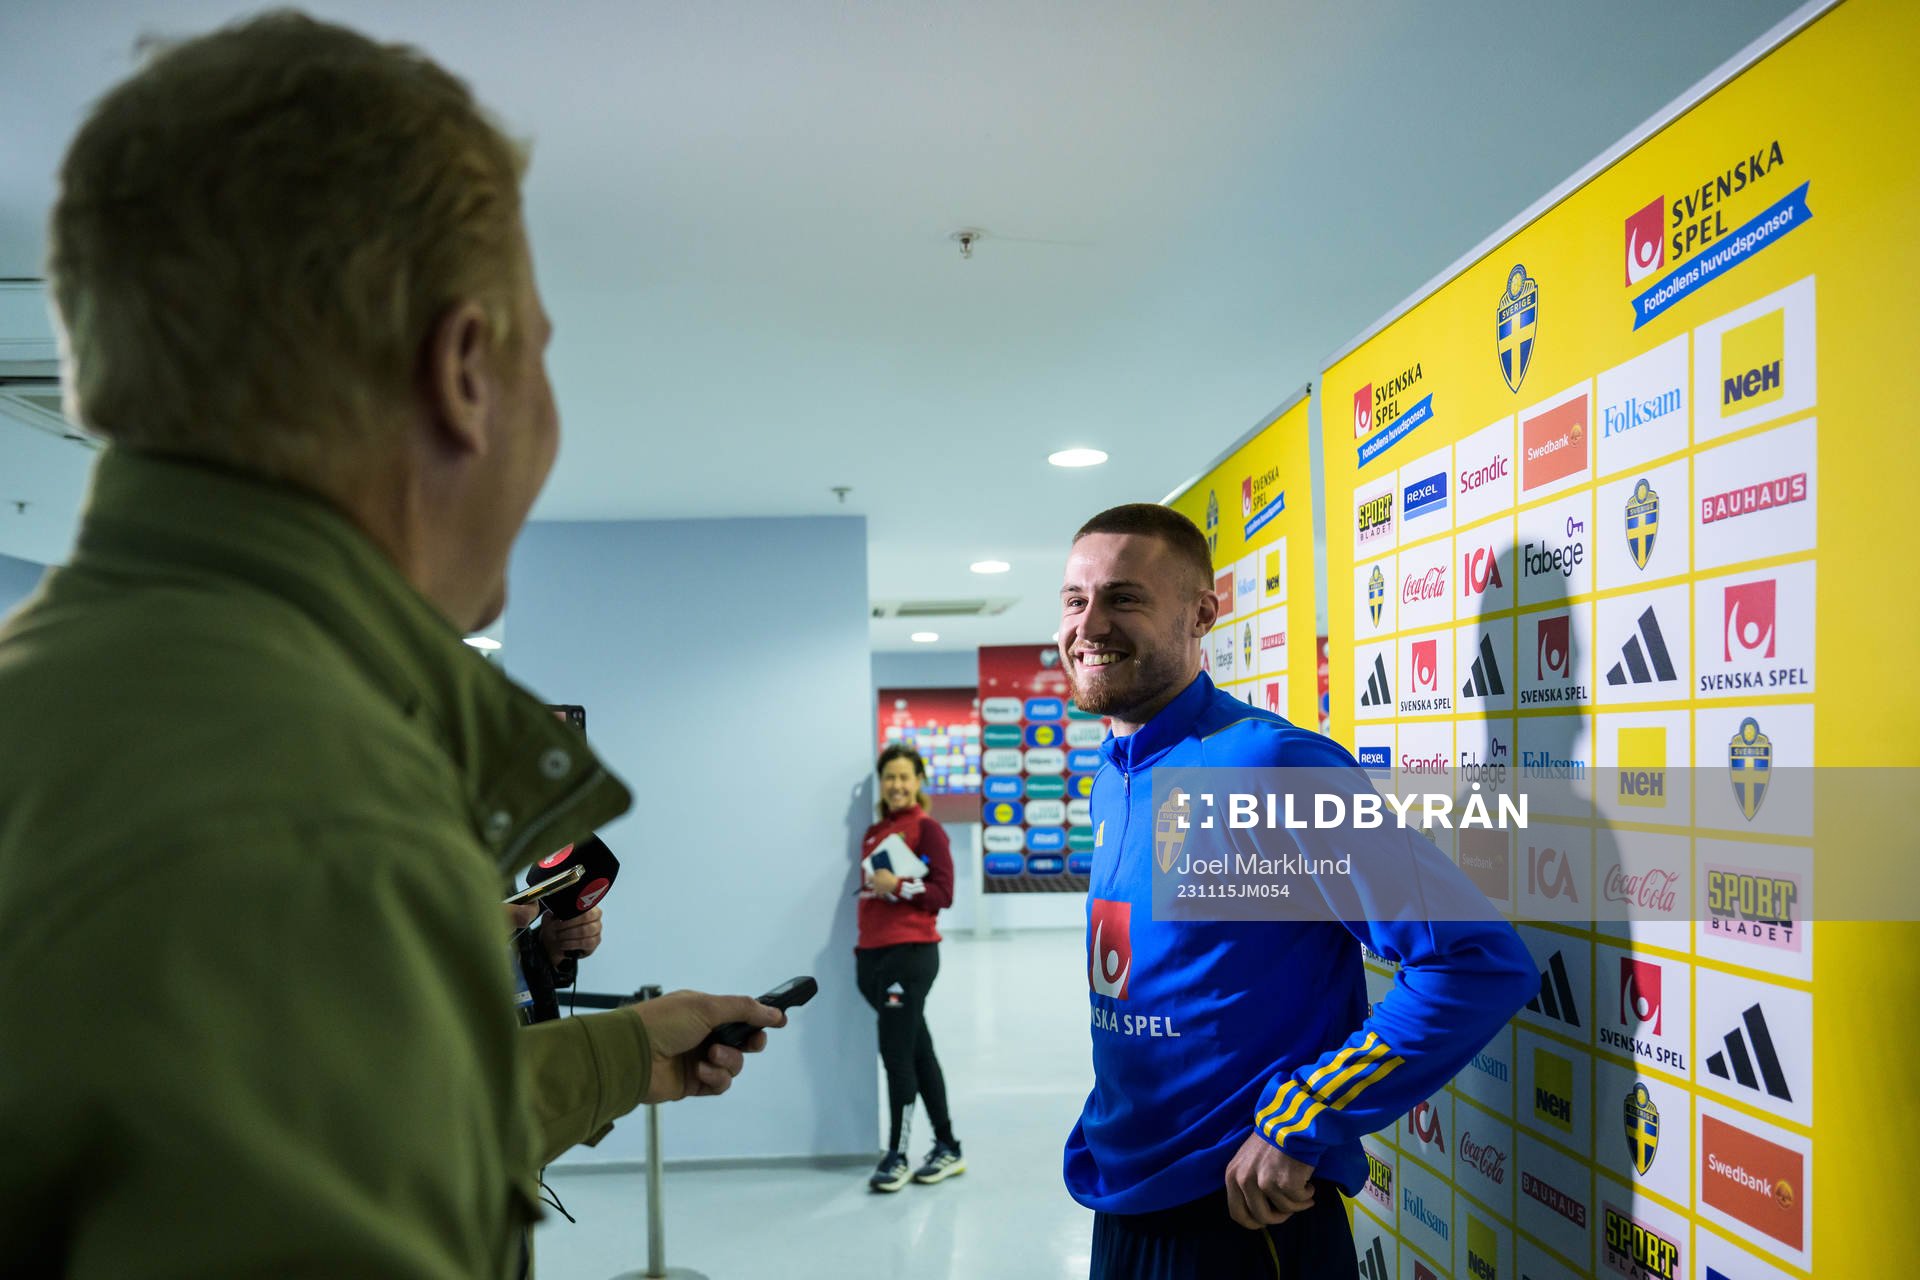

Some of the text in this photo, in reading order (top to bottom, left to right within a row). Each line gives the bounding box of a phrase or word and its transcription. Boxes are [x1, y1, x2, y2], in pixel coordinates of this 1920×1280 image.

[1672, 140, 1784, 229] SVENSKA
[1672, 210, 1728, 261] SPEL
[1644, 206, 1794, 314] Fotbollens huvudsponsor
[1375, 362, 1422, 406] SVENSKA
[1375, 400, 1400, 428] SPEL
[1603, 387, 1682, 438] Folksam
[1527, 433, 1569, 461] Swedbank
[1460, 454, 1508, 494] Scandic
[1358, 493, 1392, 532] SPORT
[1702, 474, 1806, 521] BAUHAUS
[1360, 523, 1391, 541] BLADET
[1464, 545, 1504, 597] ICA
[1524, 540, 1584, 577] Fabege
[1520, 685, 1588, 704] SVENSKA SPEL
[1700, 667, 1808, 691] SVENSKA SPEL
[1400, 698, 1452, 712] SVENSKA SPEL
[1401, 753, 1449, 775] Scandic
[1460, 751, 1507, 792] Fabege
[1522, 751, 1586, 781] Folksam
[1527, 846, 1579, 904] ICA
[1708, 870, 1797, 928] SPORT
[1712, 917, 1793, 943] BLADET
[1091, 1005, 1181, 1037] NSKA SPEL
[1600, 1027, 1686, 1071] SVENSKA SPEL
[1408, 1100, 1445, 1154] ICA
[1364, 1152, 1392, 1196] ORT
[1708, 1153, 1772, 1198] Swedbank
[1403, 1187, 1449, 1241] Folksam
[1522, 1173, 1586, 1225] BAUHAUS
[1606, 1208, 1679, 1280] SPORT
[1608, 1251, 1651, 1280] BLAD
